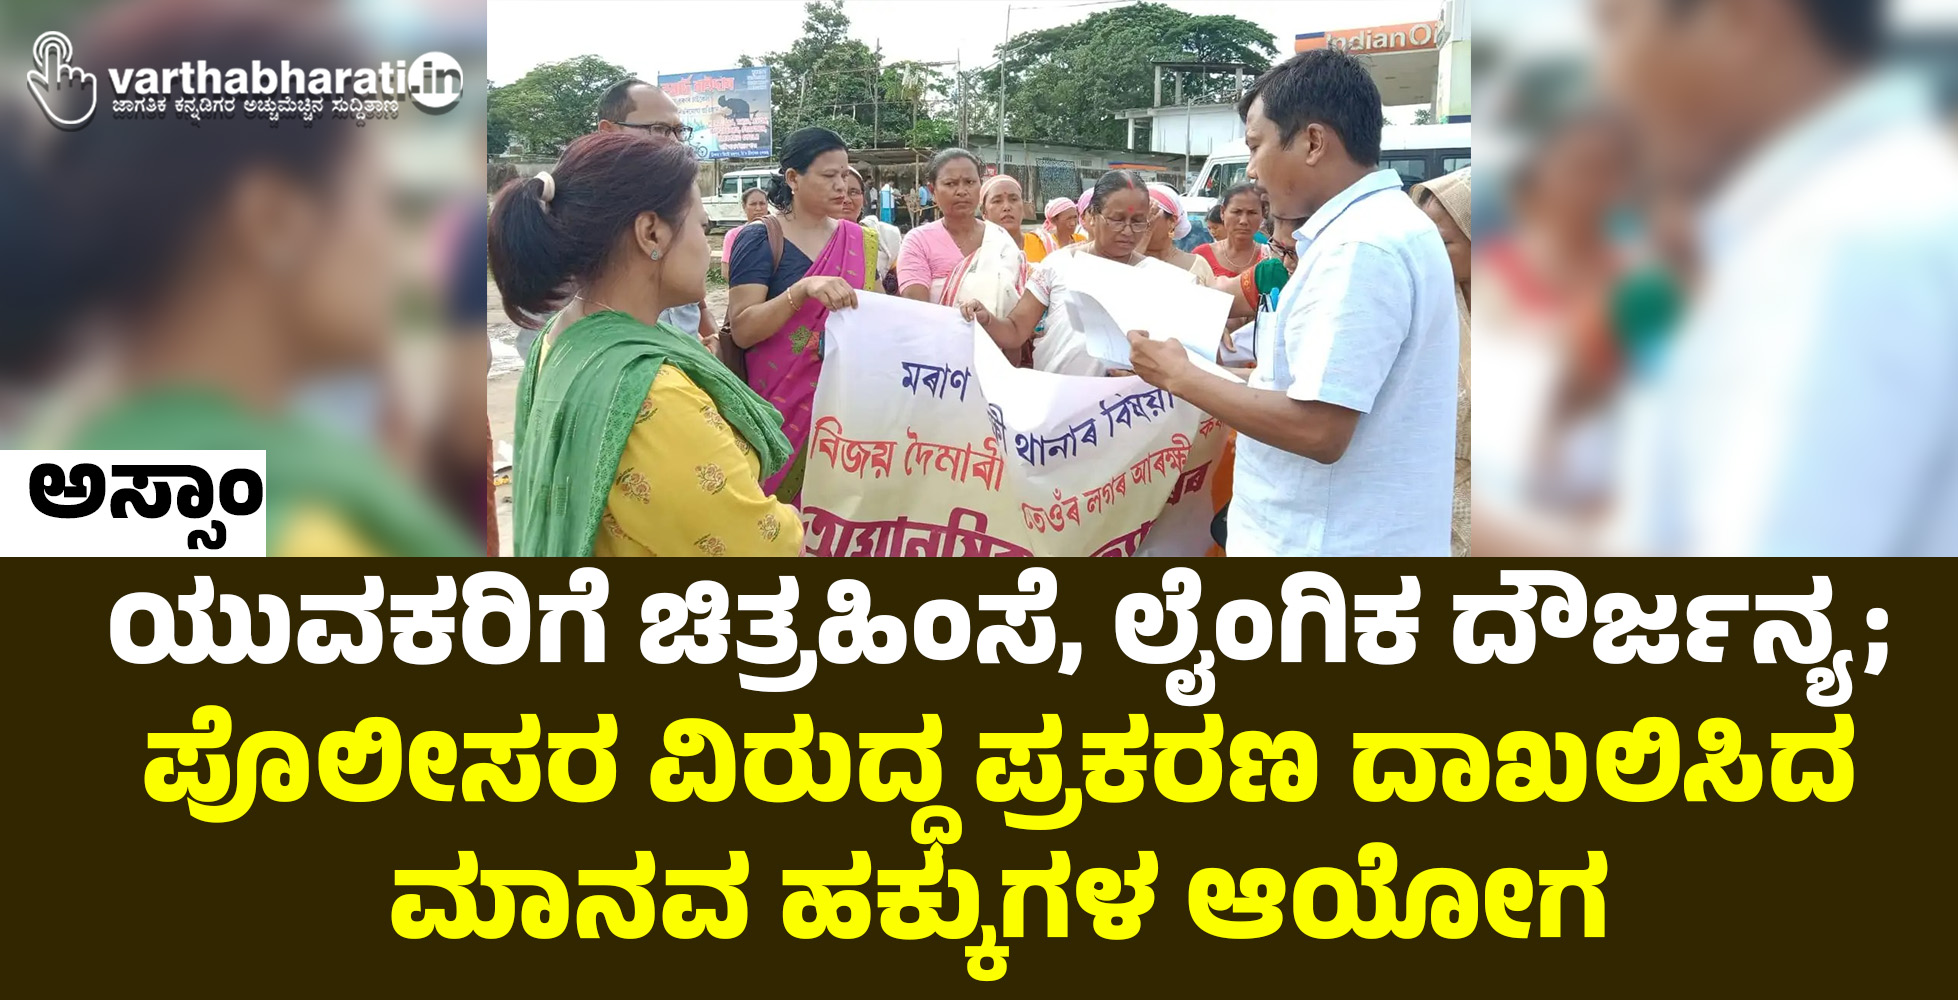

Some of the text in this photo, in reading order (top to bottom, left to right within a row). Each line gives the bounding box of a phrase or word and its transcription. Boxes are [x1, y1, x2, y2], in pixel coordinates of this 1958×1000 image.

[810, 415, 898, 479] বিজয়
[901, 361, 972, 402] মৰাণ
[1014, 418, 1099, 466] থানাৰ
